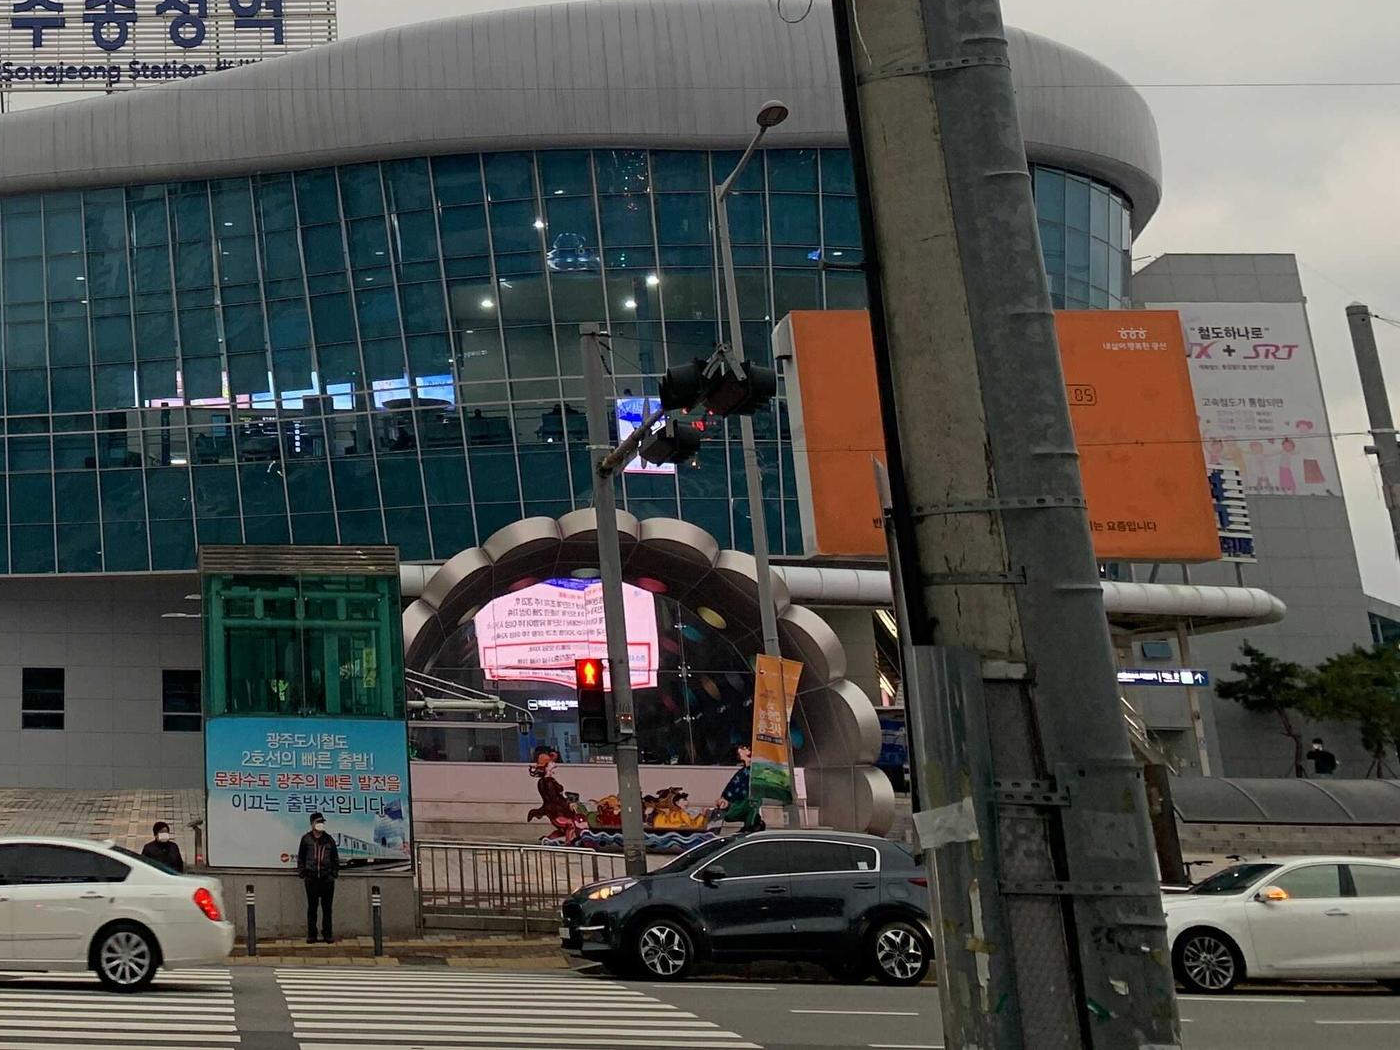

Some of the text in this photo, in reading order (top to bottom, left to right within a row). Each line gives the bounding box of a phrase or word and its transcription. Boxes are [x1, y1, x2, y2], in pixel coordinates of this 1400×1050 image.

[128, 60, 207, 80] Station
[1243, 344, 1299, 360] SRT
[1106, 521, 1157, 532] 요즘입니다
[265, 733, 349, 749] 광주도시철도
[241, 751, 375, 770] 2호선의 빠른 출발!
[214, 772, 400, 792] 문화수도 광주의 빠른 발전을
[231, 794, 385, 816] 이끄는 출발선입니다
